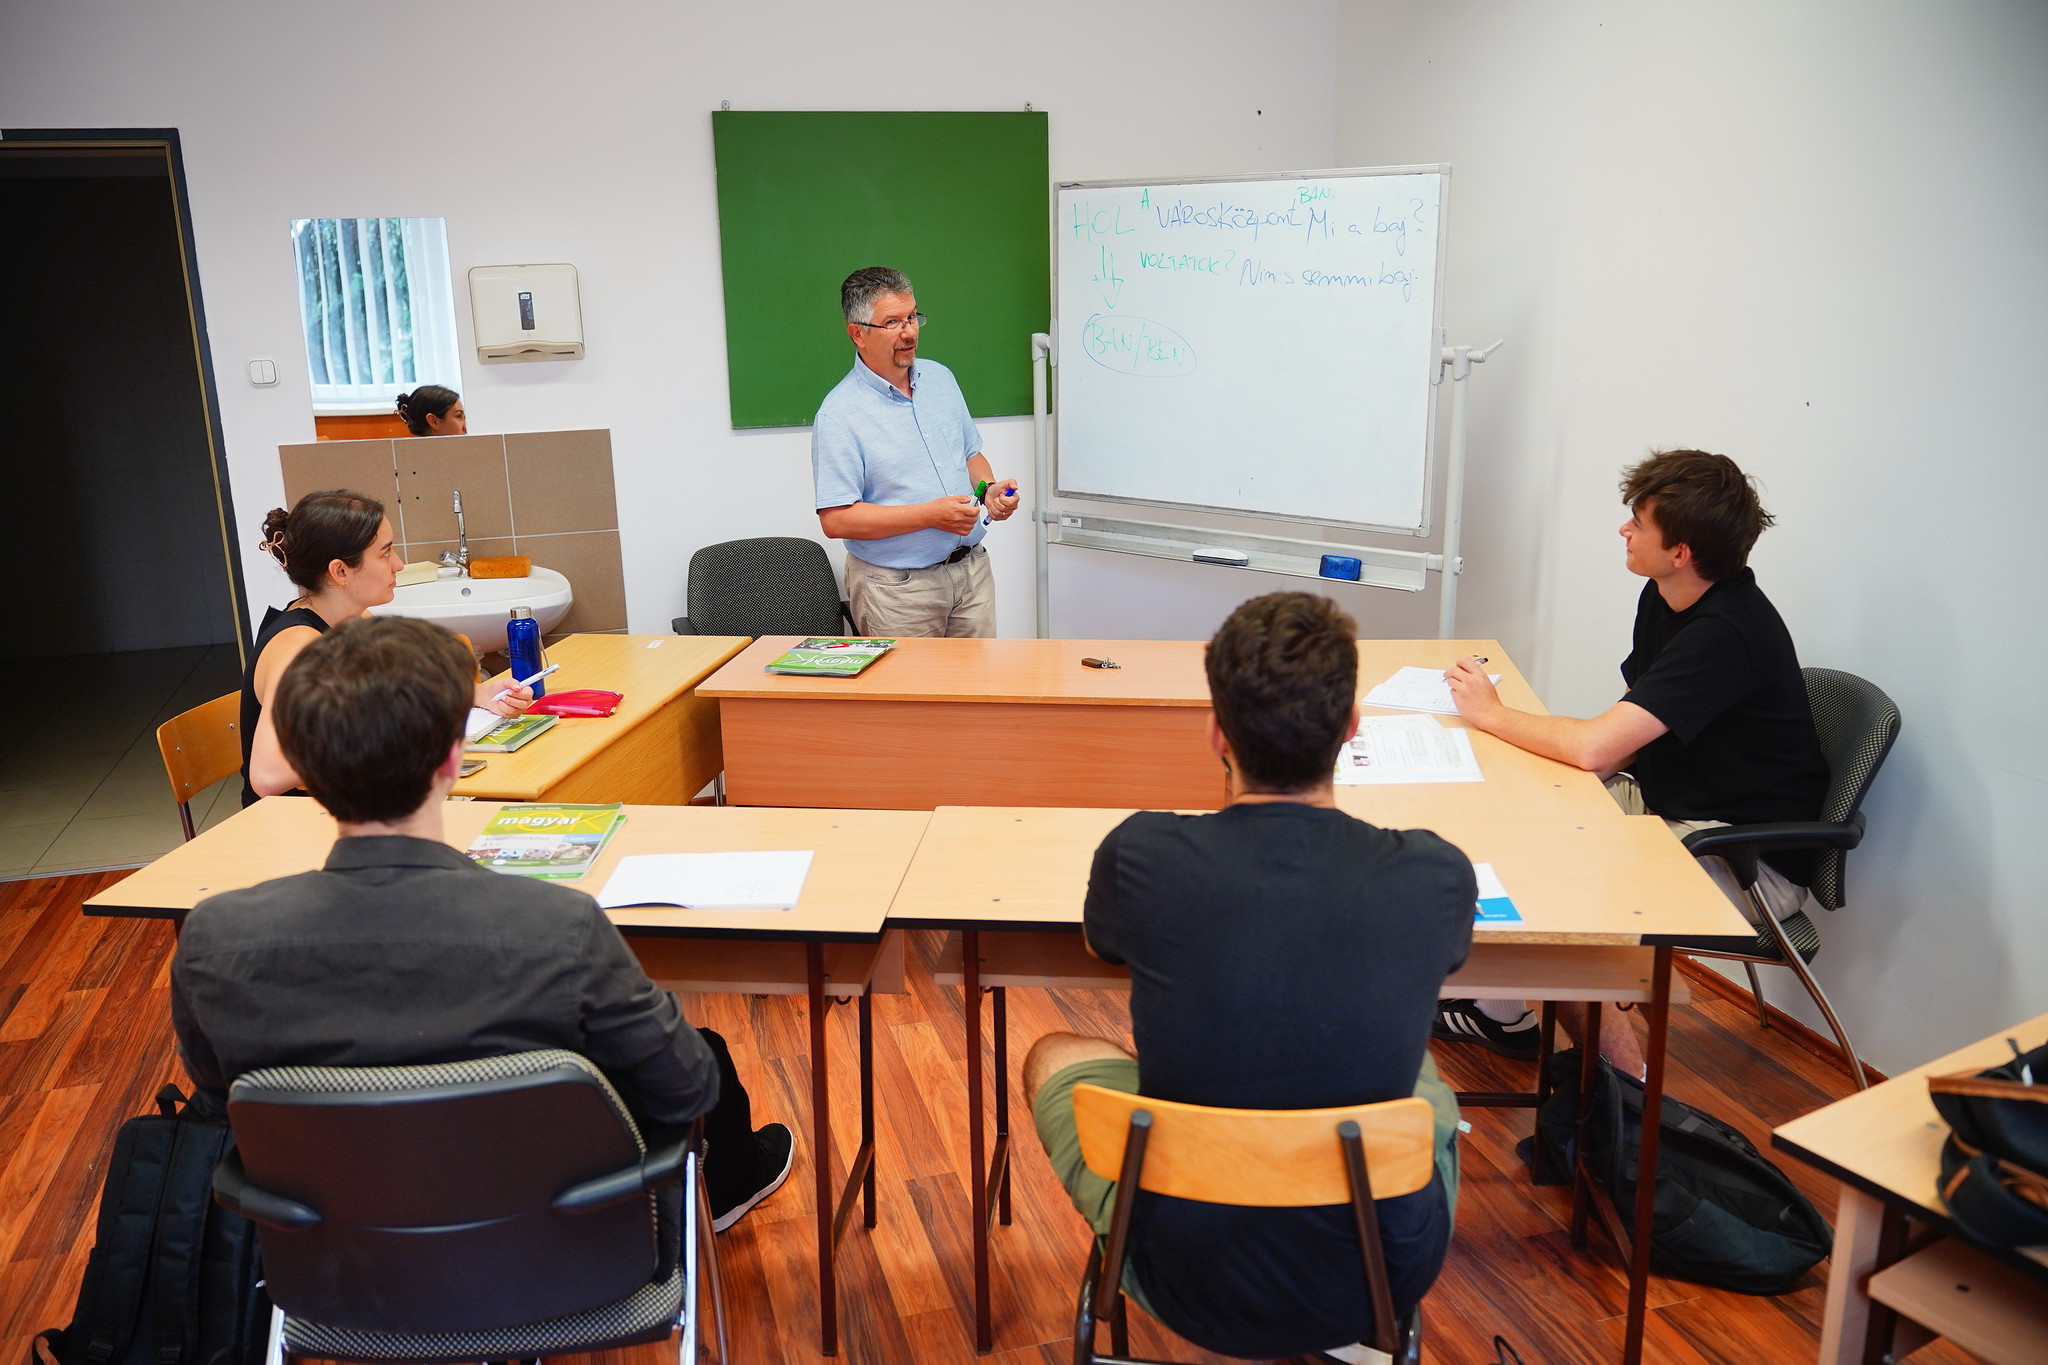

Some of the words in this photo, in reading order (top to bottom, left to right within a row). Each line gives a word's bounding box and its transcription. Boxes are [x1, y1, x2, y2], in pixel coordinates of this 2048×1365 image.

[1141, 188, 1150, 210] A
[1073, 202, 1136, 242] HOL
[1306, 206, 1335, 244] Mi
[1348, 224, 1362, 235] a
[497, 815, 582, 827] magyar
